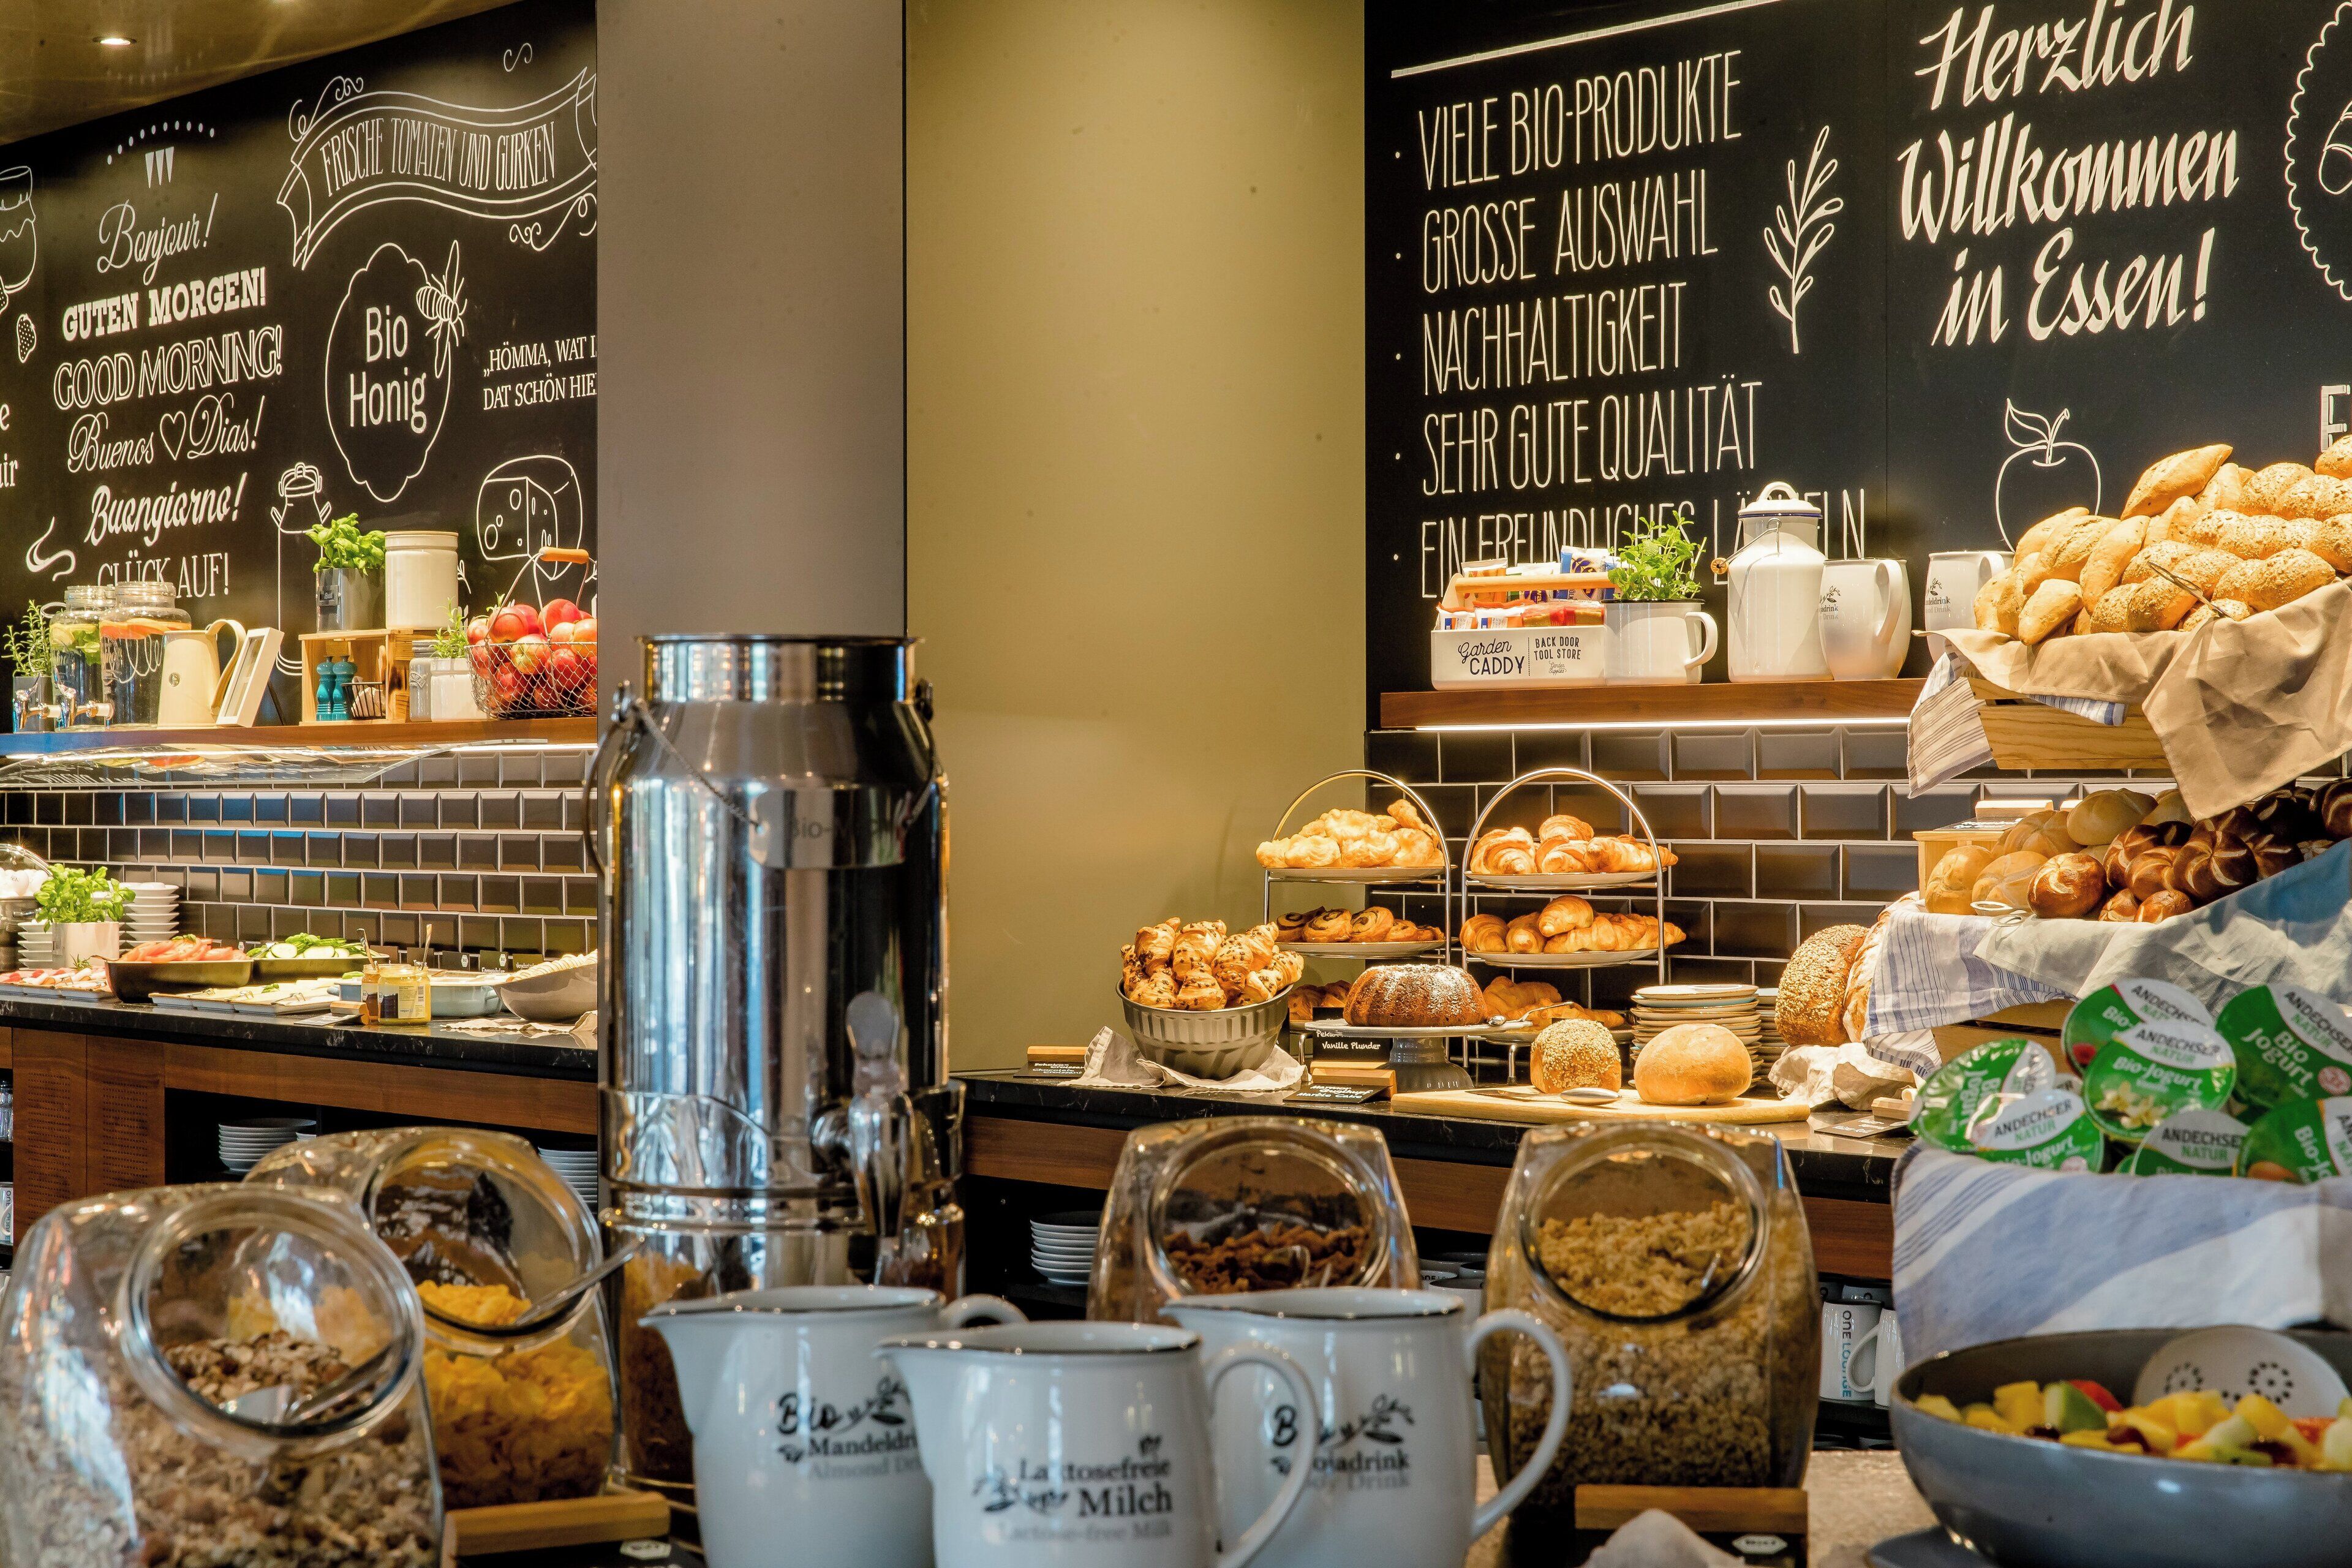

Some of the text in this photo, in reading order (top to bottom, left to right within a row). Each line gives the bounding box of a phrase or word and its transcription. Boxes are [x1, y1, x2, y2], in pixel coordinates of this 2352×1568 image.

[1915, 0, 2193, 110] Herzlich
[1419, 50, 1741, 190] VIELE BIO-PRODUKTE
[320, 118, 555, 197] FRISCHE TOMATEN UND GURKEN
[1898, 111, 2239, 243] Willkommen
[97, 193, 218, 285] Bonjour!
[1423, 169, 1718, 293] GROSSE AUSWAHL
[62, 266, 266, 341] GUTEN MORGEN!
[1931, 227, 2215, 346] in Essen!
[53, 325, 283, 410] GOOD MORNING!
[366, 305, 409, 363] Bio
[554, 336, 587, 363] WAT
[1423, 282, 1687, 395] NACHHALTIGKEIT
[350, 367, 427, 434] Honig
[483, 372, 597, 410] DAT SCHÖN HIE
[67, 412, 154, 472] Buenos
[1423, 374, 1762, 496] SEHR GUTE QUALITÄT
[84, 472, 248, 546] Buongiorno!
[176, 552, 229, 598] AUF!
[1422, 517, 1466, 598] EIN
[1458, 638, 1512, 664] Garden
[1470, 656, 1525, 675] CADDY
[1534, 648, 1581, 660] TOOL STORE
[1535, 636, 1580, 648] BACK DOOR
[1351, 1041, 1381, 1050] Plunder
[2272, 1030, 2309, 1063] Bio
[2161, 1126, 2243, 1148] ANDECHSE
[1077, 1480, 1174, 1518] Milch
